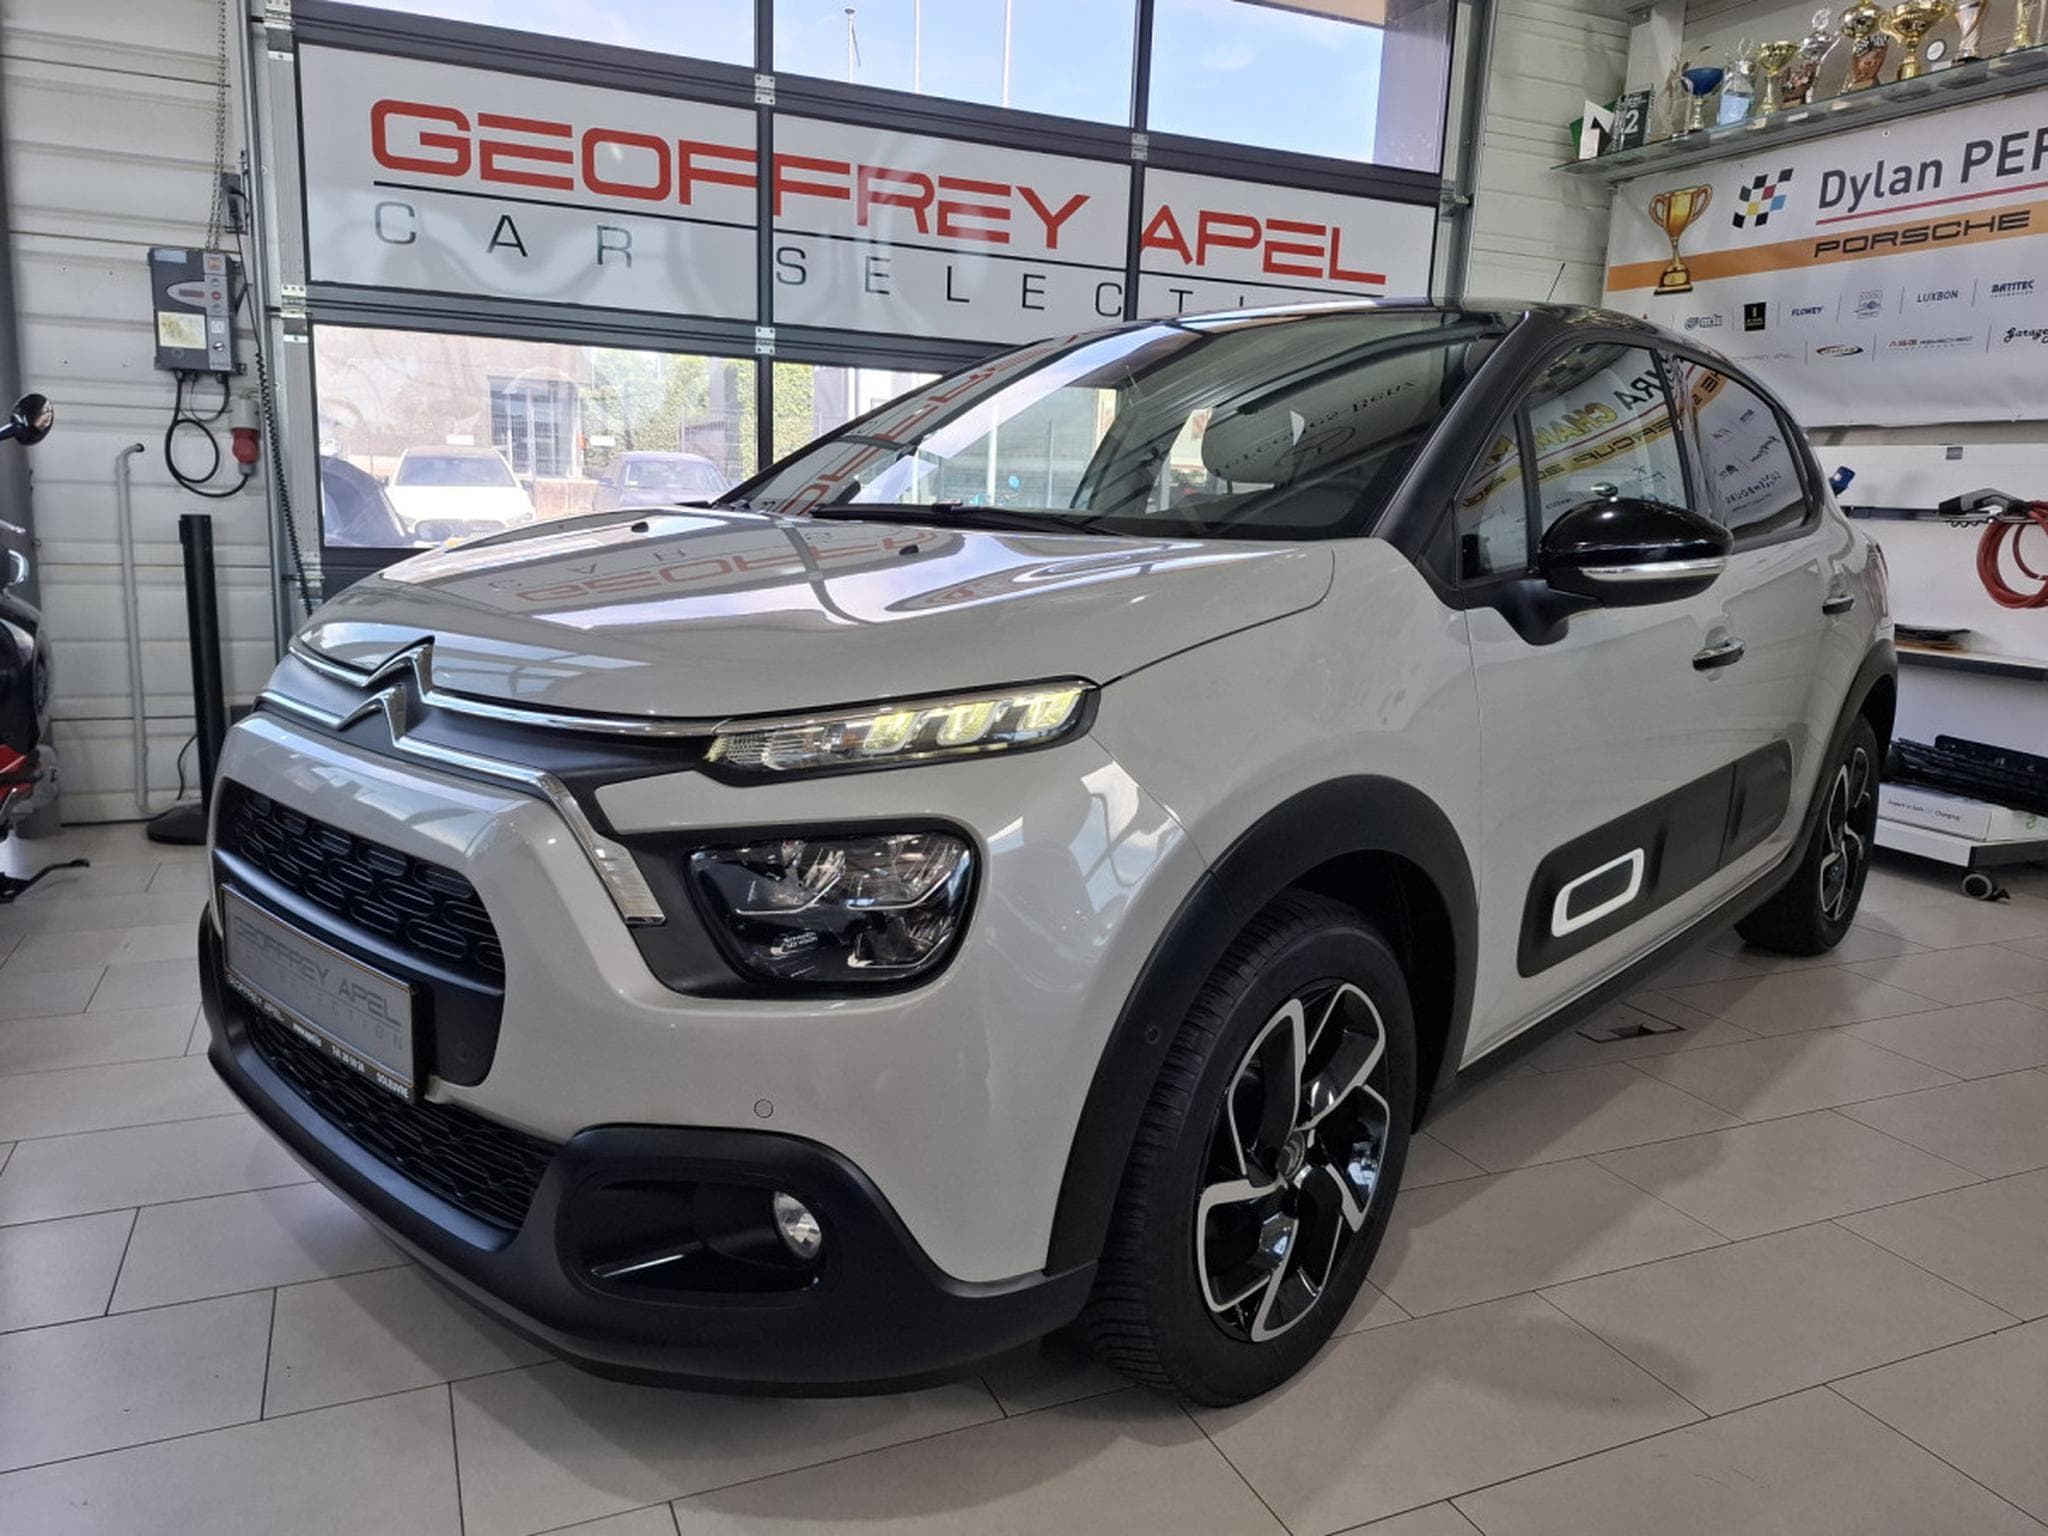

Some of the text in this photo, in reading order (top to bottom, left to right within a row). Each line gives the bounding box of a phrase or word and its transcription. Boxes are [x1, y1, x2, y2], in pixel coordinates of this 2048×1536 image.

[370, 99, 1386, 285] GEOFFREY APEL
[1819, 160, 1943, 213] Dylan
[375, 202, 633, 268] CAR
[1814, 210, 2031, 258] PORSCHE
[1917, 290, 1959, 303] LUXBON
[338, 978, 401, 1027] APEL
